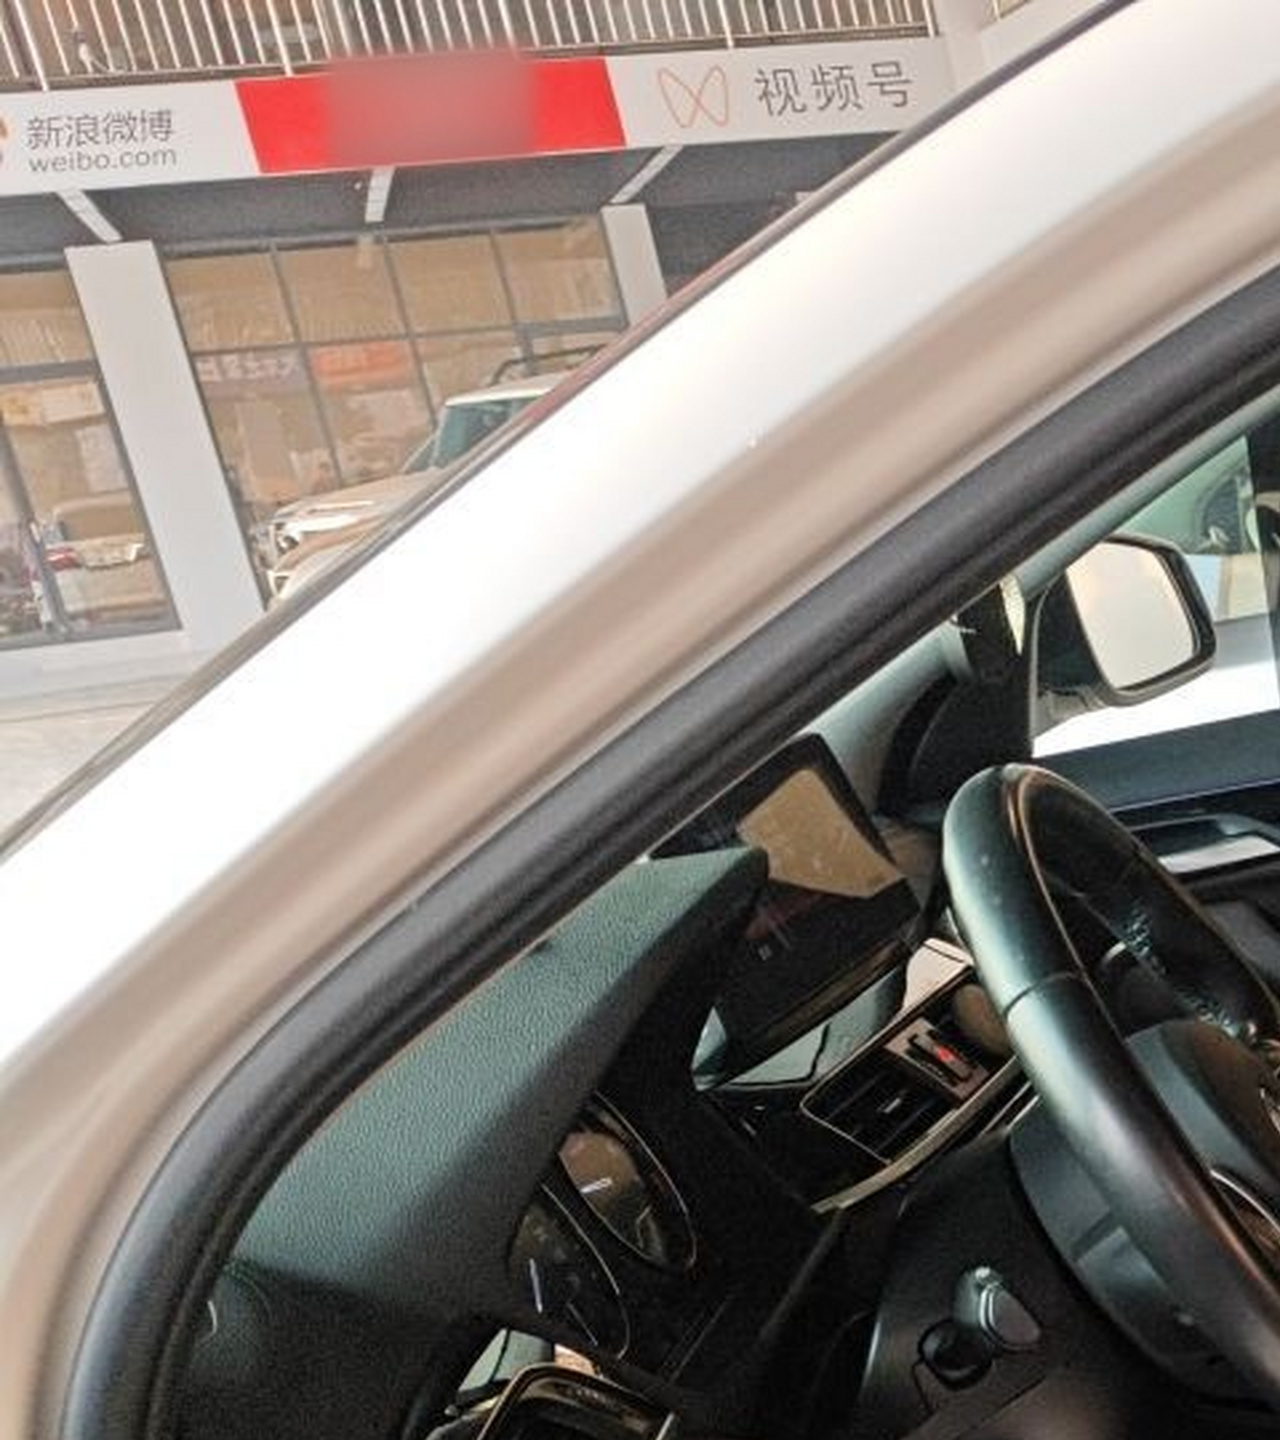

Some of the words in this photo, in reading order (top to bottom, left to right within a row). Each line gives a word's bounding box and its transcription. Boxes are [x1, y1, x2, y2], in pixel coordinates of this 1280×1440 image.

[754, 60, 913, 116] 视频号
[28, 109, 176, 150] 新浪微博
[28, 149, 177, 172] weibo.com
